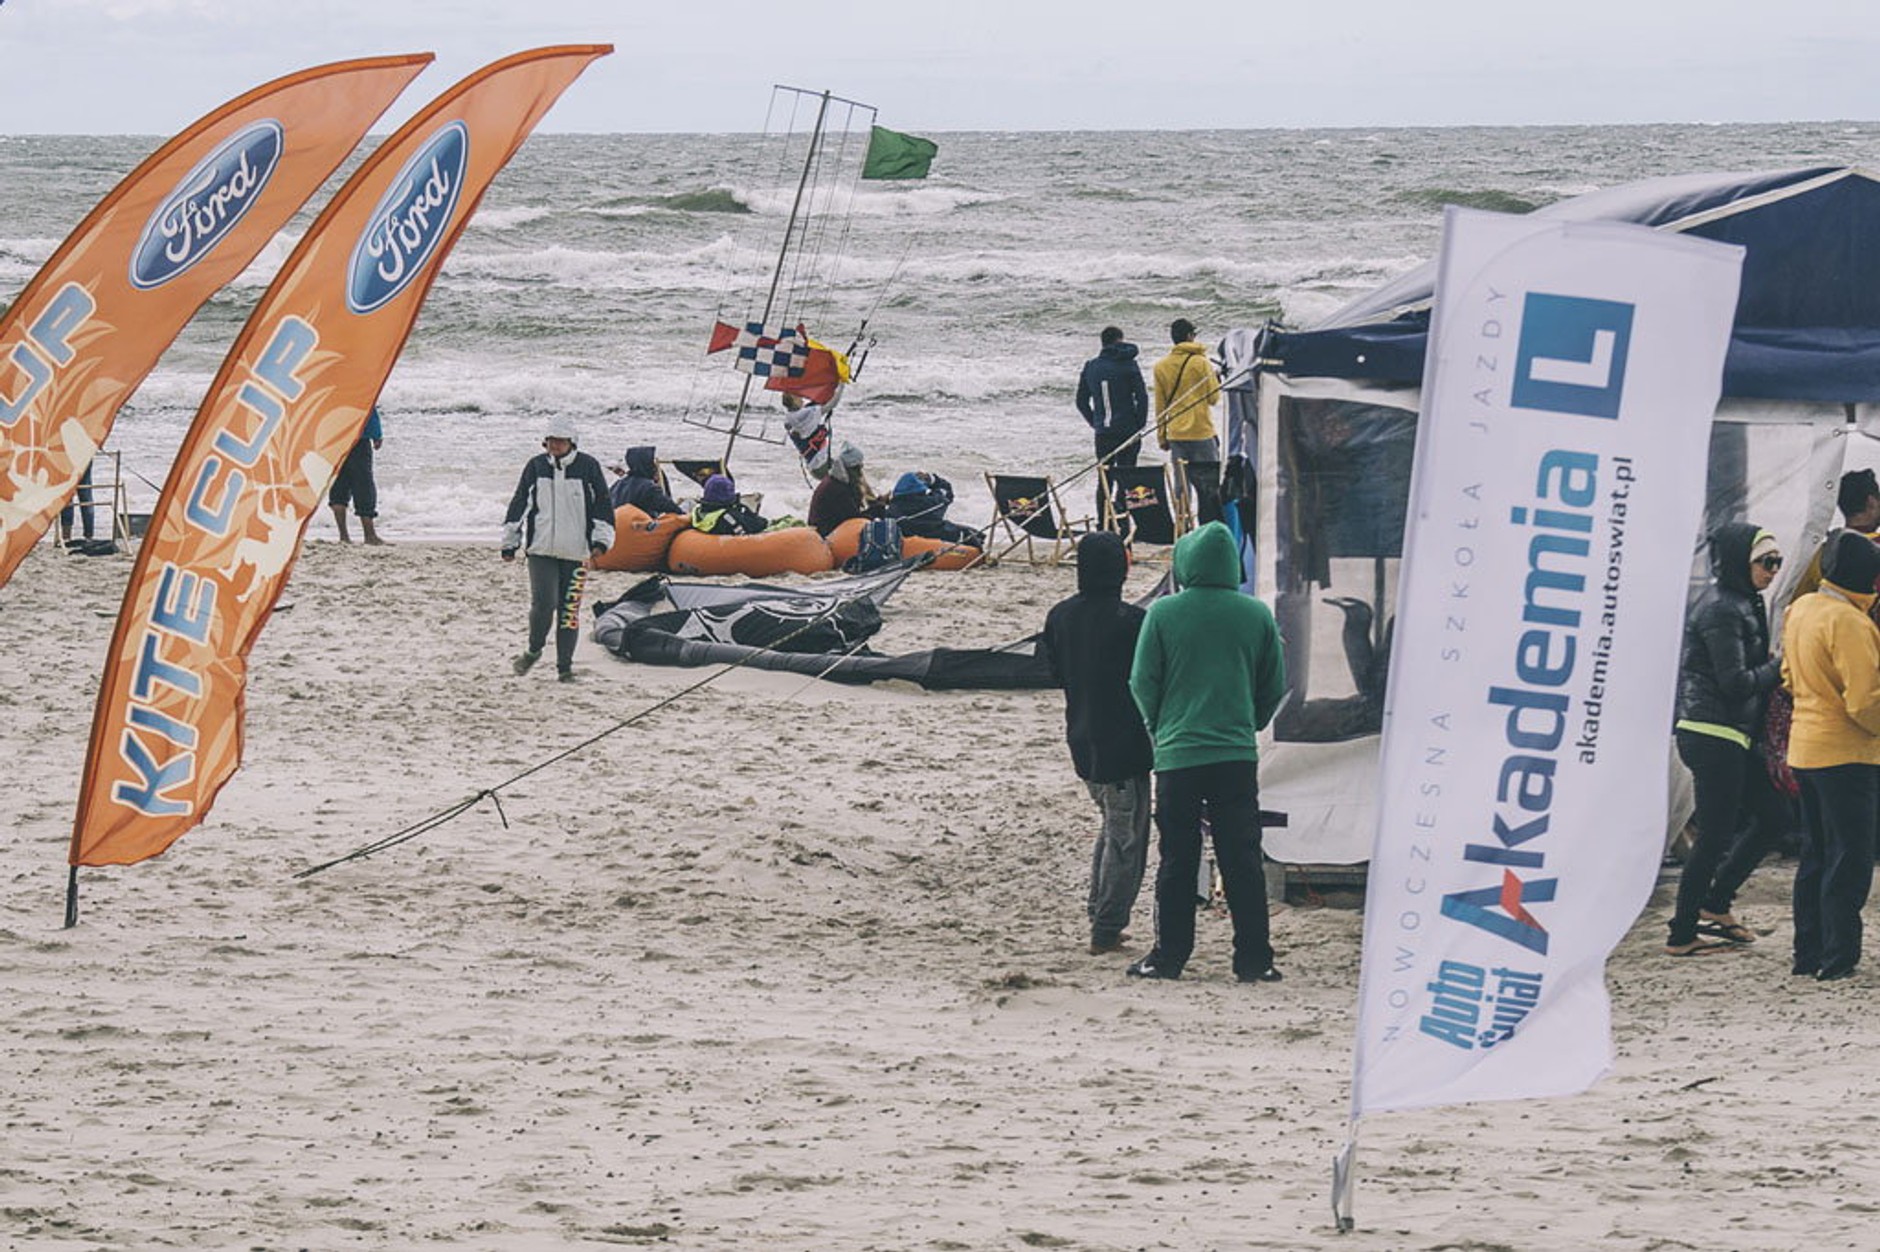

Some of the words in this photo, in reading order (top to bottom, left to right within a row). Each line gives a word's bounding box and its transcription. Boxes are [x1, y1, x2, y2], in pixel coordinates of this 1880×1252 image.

[160, 152, 257, 263] Ford
[367, 158, 450, 283] Ford
[0, 281, 97, 428] UP
[111, 561, 218, 817] KITE
[184, 314, 320, 537] CUP
[1383, 713, 1451, 1042] NOWOCZESNA
[1442, 483, 1481, 662] SZKOŁA
[1469, 288, 1506, 433] JAZDY
[1576, 456, 1637, 765] akademia.autoswiat.pl
[1440, 449, 1599, 956] Akademia
[1419, 960, 1486, 1050] Auto
